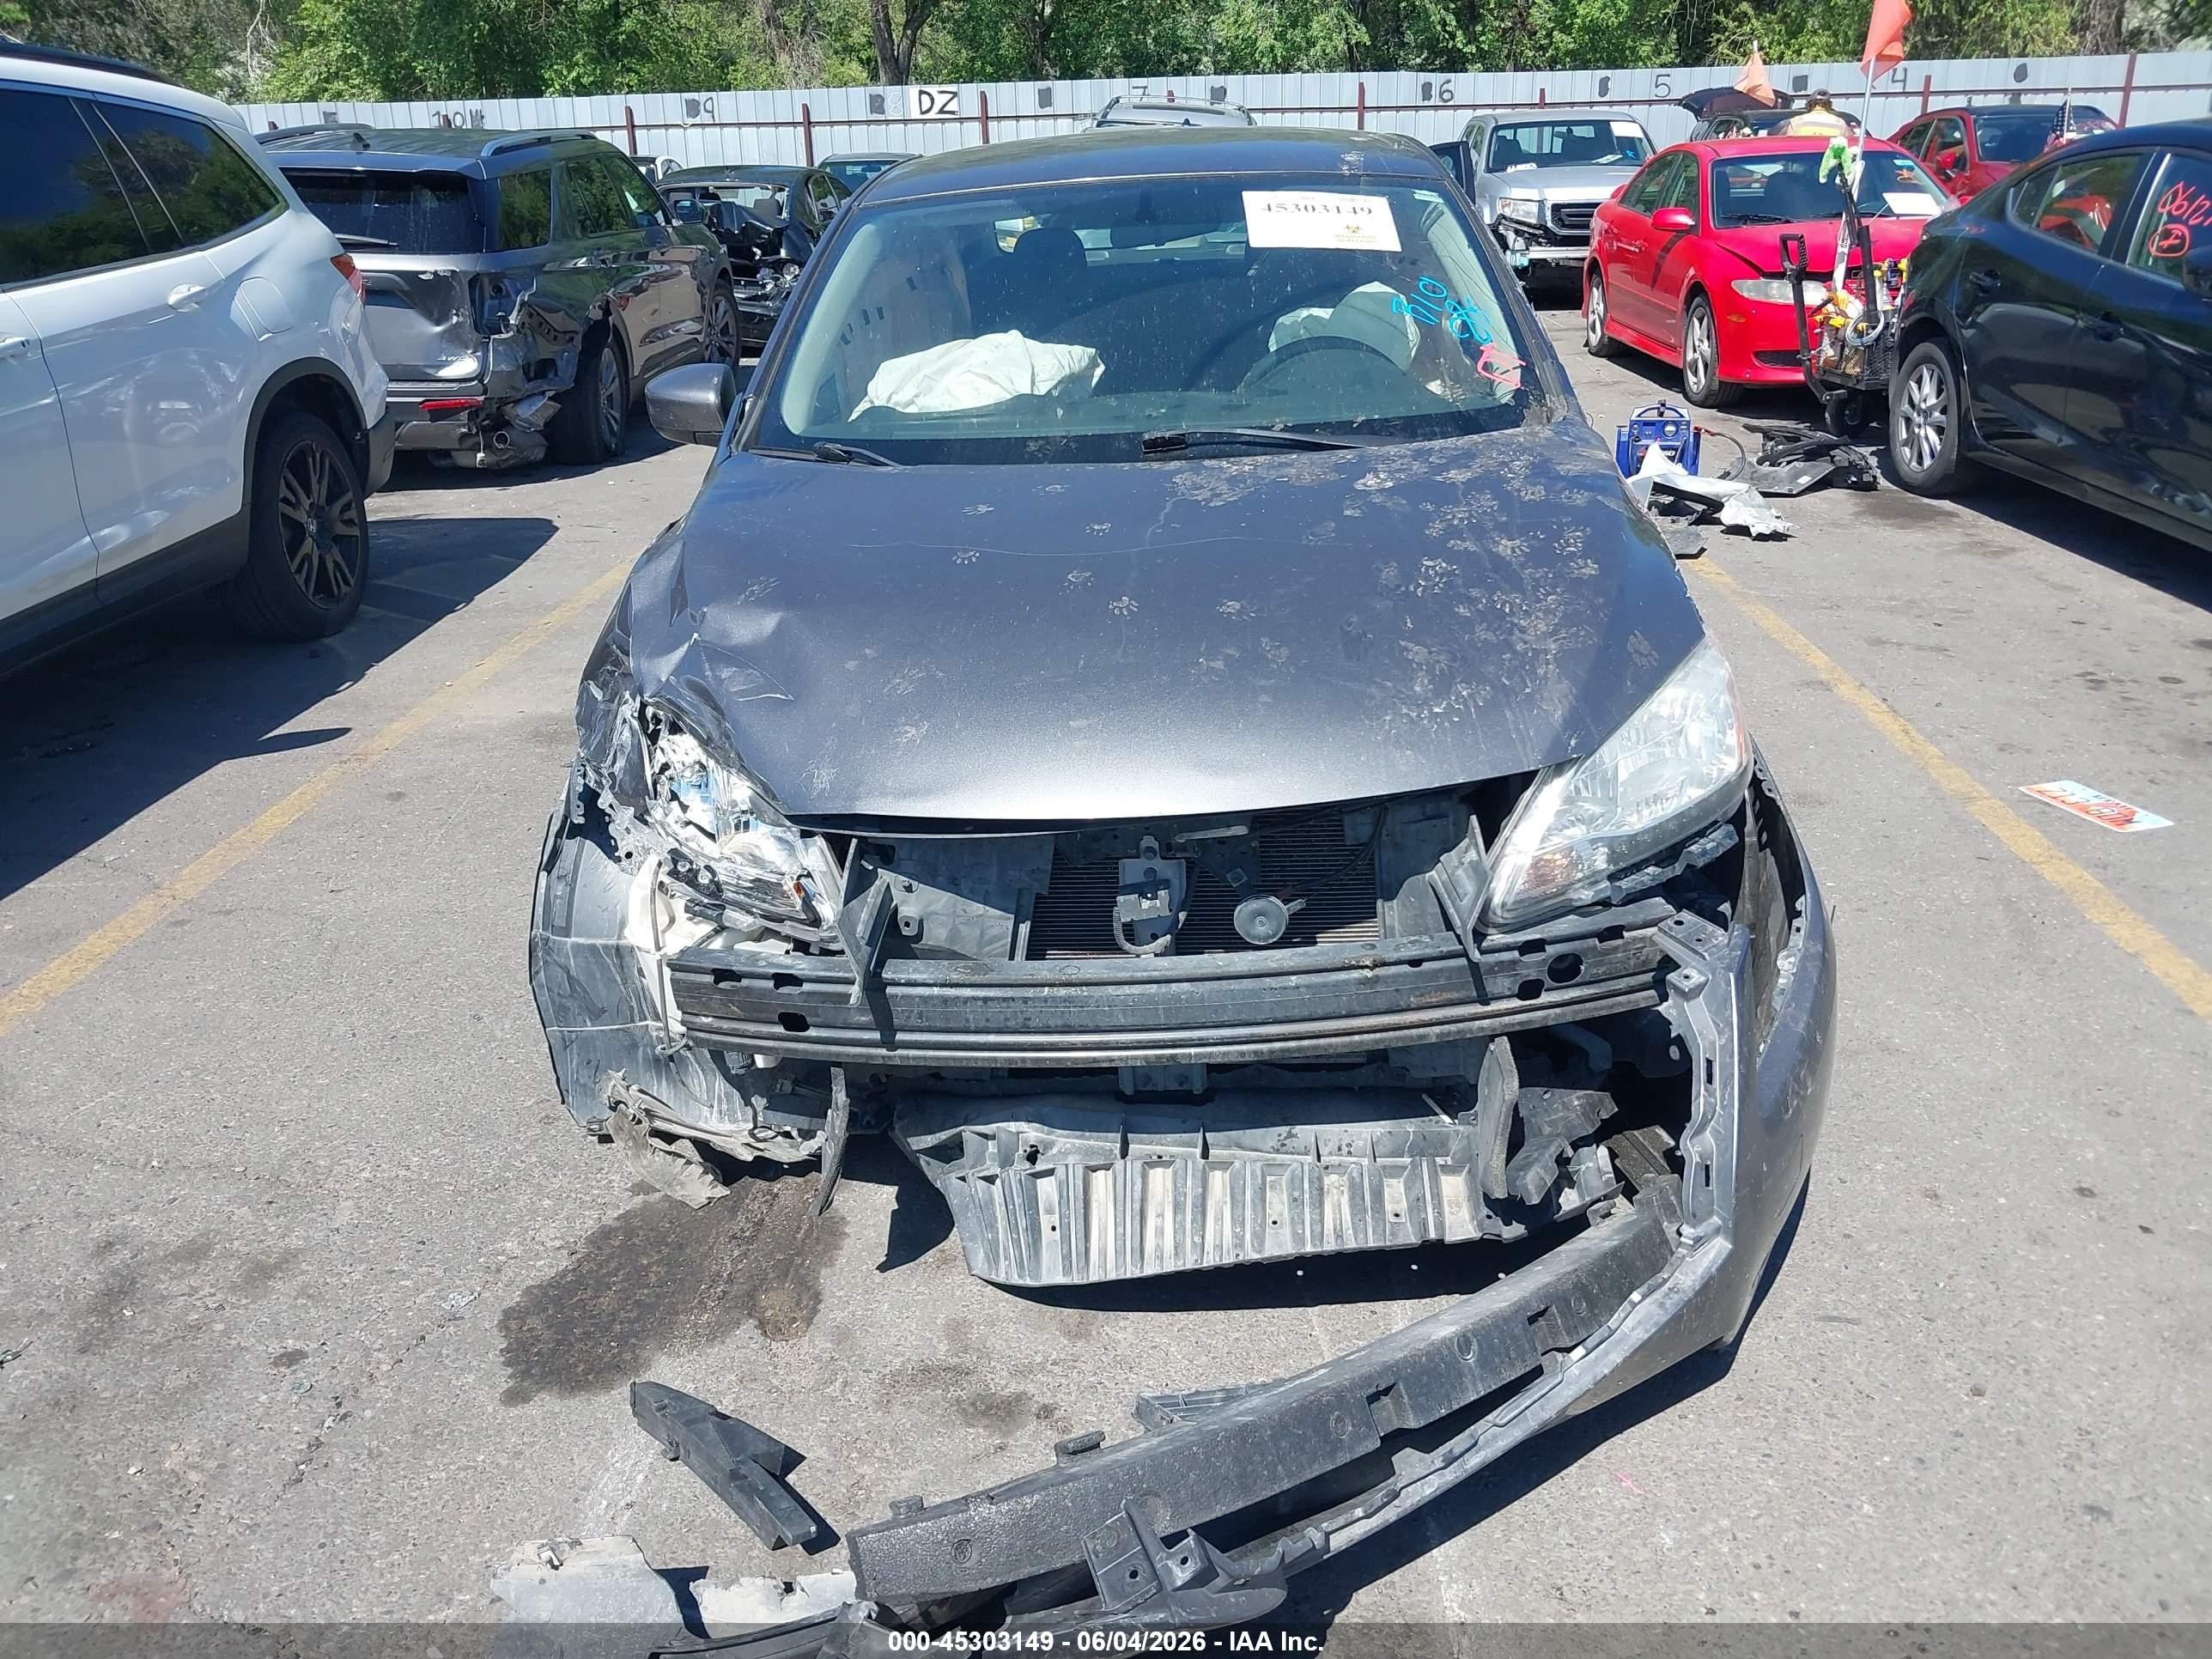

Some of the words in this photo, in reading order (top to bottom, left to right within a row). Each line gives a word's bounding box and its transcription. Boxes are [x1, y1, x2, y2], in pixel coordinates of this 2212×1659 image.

[1438, 79, 1454, 103] 6
[1655, 74, 1671, 98] 5
[1891, 68, 1907, 92] 4
[918, 89, 959, 115] DZ
[1261, 203, 1373, 216] 45303149
